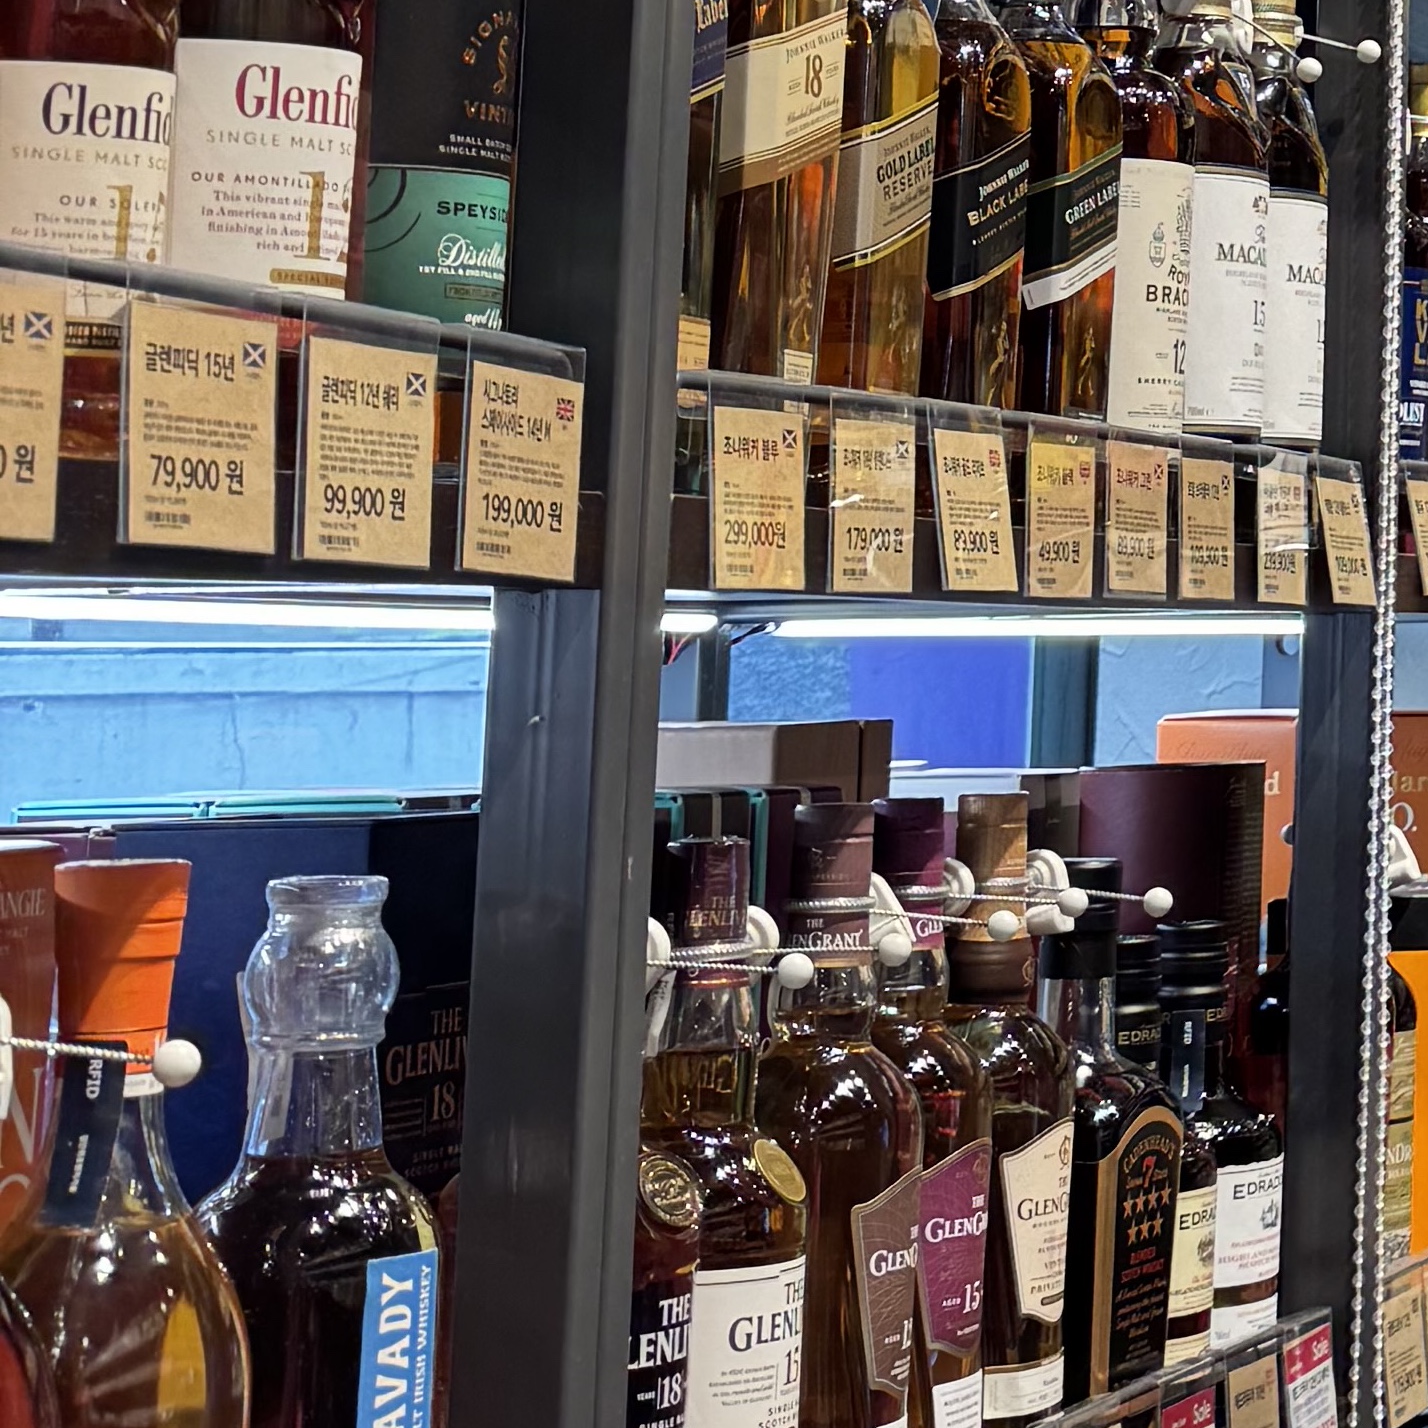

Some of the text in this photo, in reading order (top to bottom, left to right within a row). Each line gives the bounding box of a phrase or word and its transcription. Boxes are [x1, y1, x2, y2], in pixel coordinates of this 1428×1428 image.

[804, 54, 824, 99] 18
[11, 144, 141, 168] SINGLE MALT
[206, 128, 334, 153] SINGLE MALT
[191, 170, 226, 184] OUR
[876, 137, 936, 185] GOLD LABEL
[882, 161, 934, 202] RESERVE
[59, 193, 98, 210] OUR
[968, 193, 1005, 228] BLACK
[1065, 194, 1096, 227] GREEN
[145, 342, 236, 383] 글렌피딕 15년
[723, 435, 759, 462] 조니워커
[149, 453, 244, 496] 79,900 원
[323, 483, 406, 522] 99,900 원
[481, 492, 563, 534] 199,000 원
[723, 518, 787, 551] 299,000원
[430, 1006, 462, 1037] THE
[429, 1083, 457, 1120] 18
[416, 1264, 432, 1350] WHISKEY
[963, 1280, 981, 1314] 15
[662, 1373, 682, 1409] 18
